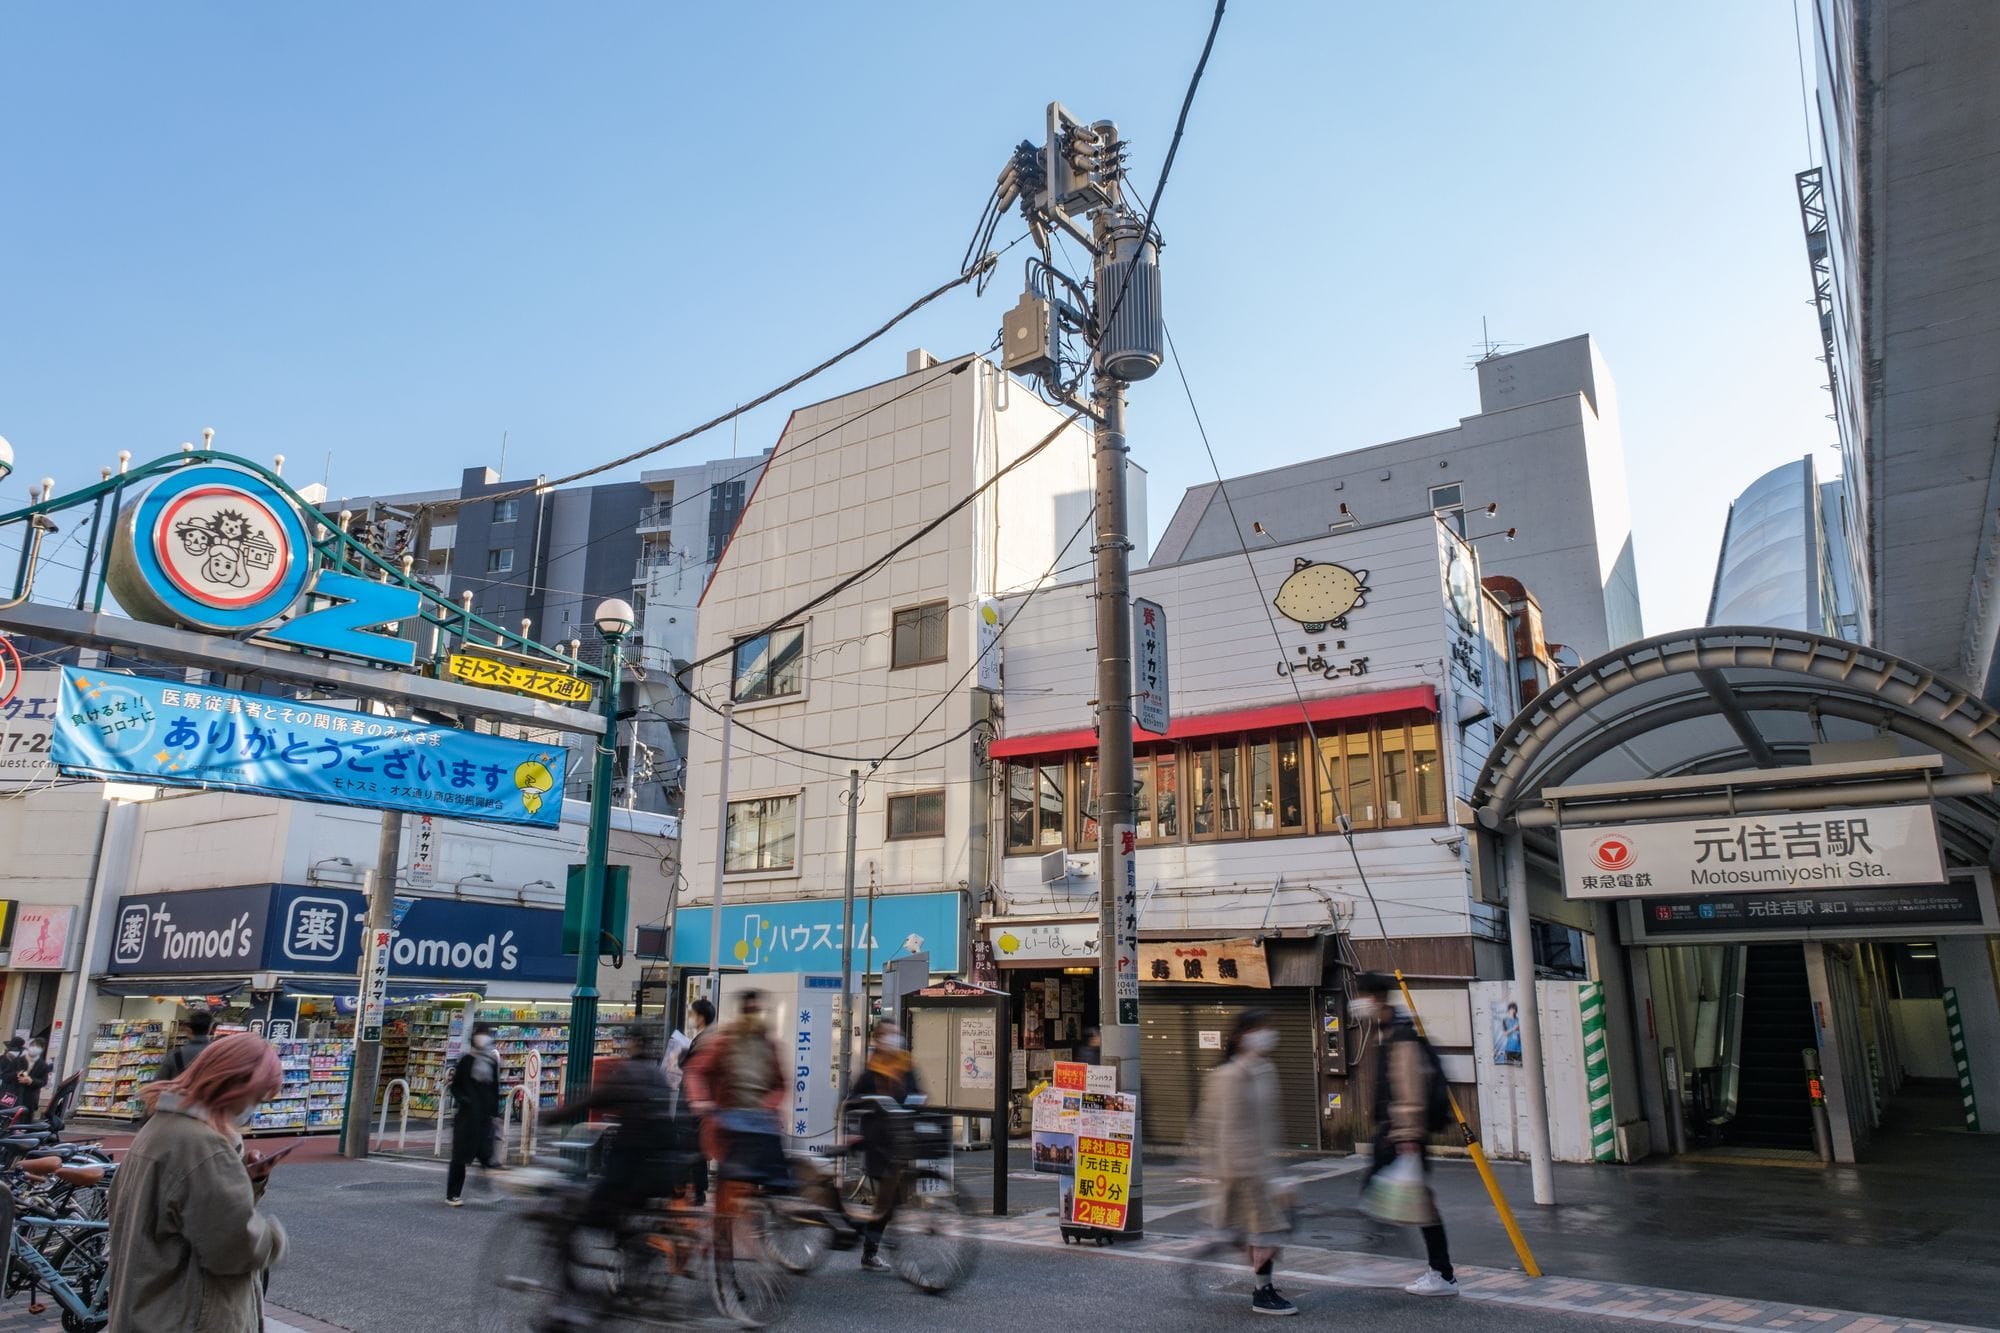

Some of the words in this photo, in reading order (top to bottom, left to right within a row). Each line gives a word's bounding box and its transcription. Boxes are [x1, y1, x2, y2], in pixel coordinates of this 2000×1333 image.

[455, 657, 587, 699] モトスミ・オズ通り
[1146, 639, 1157, 690] サカマ
[1277, 655, 1369, 680] いーはとーぶ
[101, 711, 156, 736] コロナに
[162, 688, 443, 747] 医療従事者とその関係者のみなさま
[164, 716, 508, 792] ありがとうございます
[332, 777, 504, 810] モトスミ・オズ通り商店街振興組合
[419, 831, 431, 862] サカマ
[1694, 818, 1874, 863] 元住吉駅
[1581, 872, 1653, 889] 東急電鉄
[1691, 863, 1842, 884] Motosumiyoshi
[1848, 861, 1891, 878] Sta.
[1748, 900, 1815, 916] 元住吉駅
[120, 914, 144, 953] 薬
[162, 911, 252, 960] Tomod's
[294, 907, 338, 950] 薬
[769, 922, 879, 952] ハウスコム
[372, 966, 385, 1001] サカマ
[271, 1023, 289, 1041] 薬
[796, 1031, 811, 1113] Ki-Re-i
[1080, 1139, 1129, 1157] 弊社限定
[1080, 1155, 1128, 1175] 「元住吉」
[1079, 1174, 1123, 1200] 駅9分
[1078, 1201, 1121, 1227] 2階建
